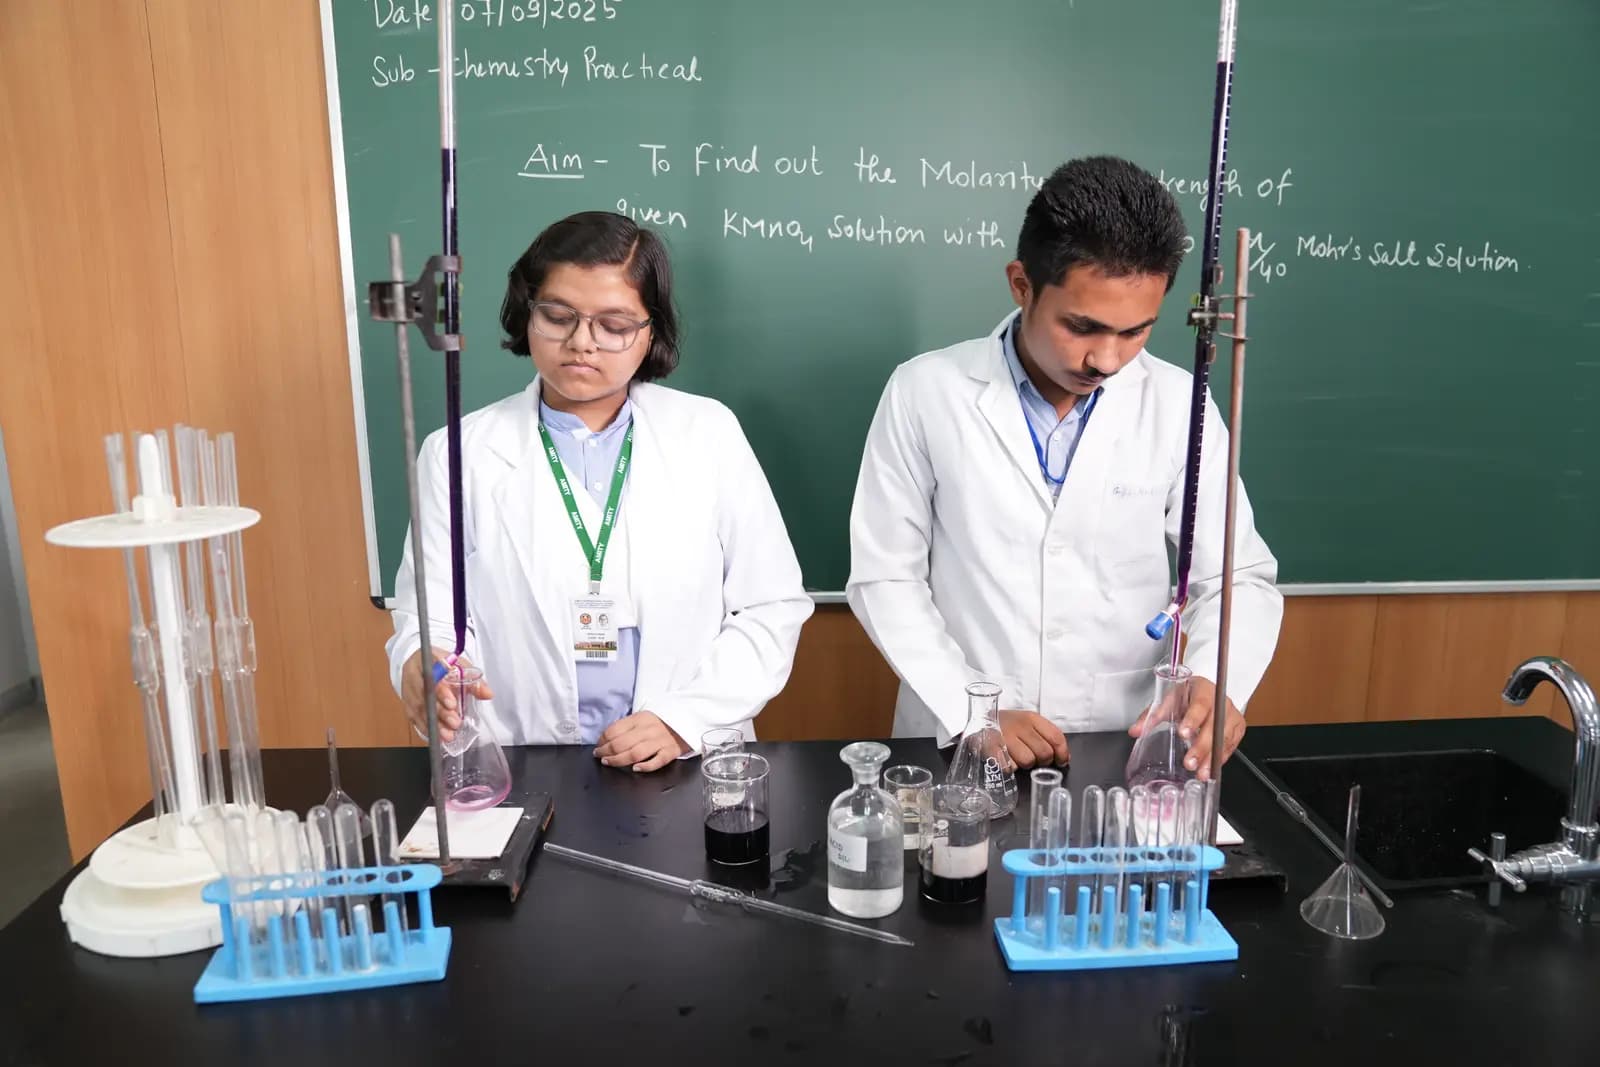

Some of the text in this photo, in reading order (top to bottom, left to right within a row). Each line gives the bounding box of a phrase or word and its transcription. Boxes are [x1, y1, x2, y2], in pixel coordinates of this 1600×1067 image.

[373, 0, 432, 29] Date
[372, 54, 415, 87] Sub
[583, 45, 702, 81] Practical
[523, 143, 584, 173] Aim
[638, 143, 671, 177] To
[695, 142, 761, 177] Find
[774, 144, 823, 176] out
[853, 146, 897, 183] the
[1257, 168, 1294, 206] of
[943, 220, 1006, 248] with
[1296, 233, 1361, 261] Mohr's
[548, 446, 559, 463] AMITY
[617, 455, 627, 474] AMITY
[559, 478, 571, 496] AMITY
[570, 511, 583, 529] AMITY
[604, 505, 615, 527] AMITY
[594, 541, 605, 564] AMITY
